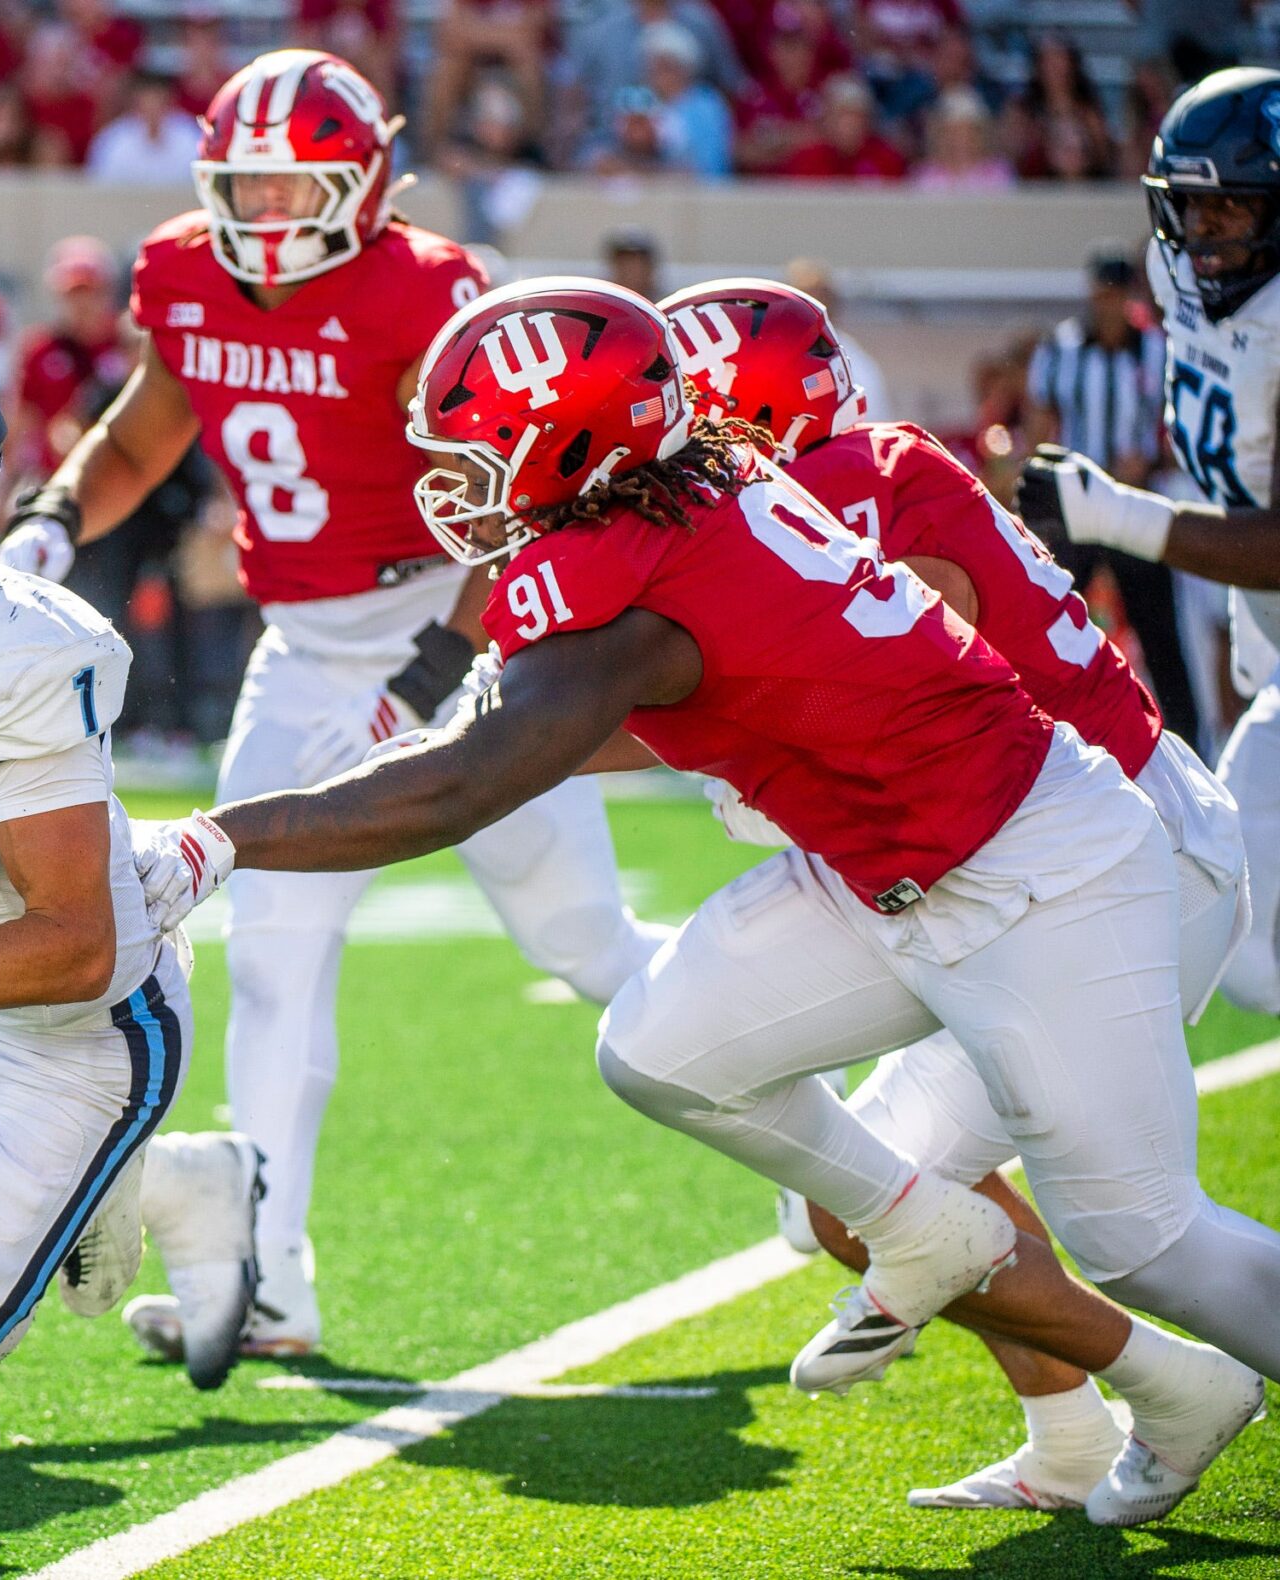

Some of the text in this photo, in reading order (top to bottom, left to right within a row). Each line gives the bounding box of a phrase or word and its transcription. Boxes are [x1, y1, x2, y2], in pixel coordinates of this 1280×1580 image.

[181, 331, 350, 400] INDIANA
[221, 400, 331, 542] 8
[507, 560, 574, 640] 91
[72, 666, 100, 738] 1
